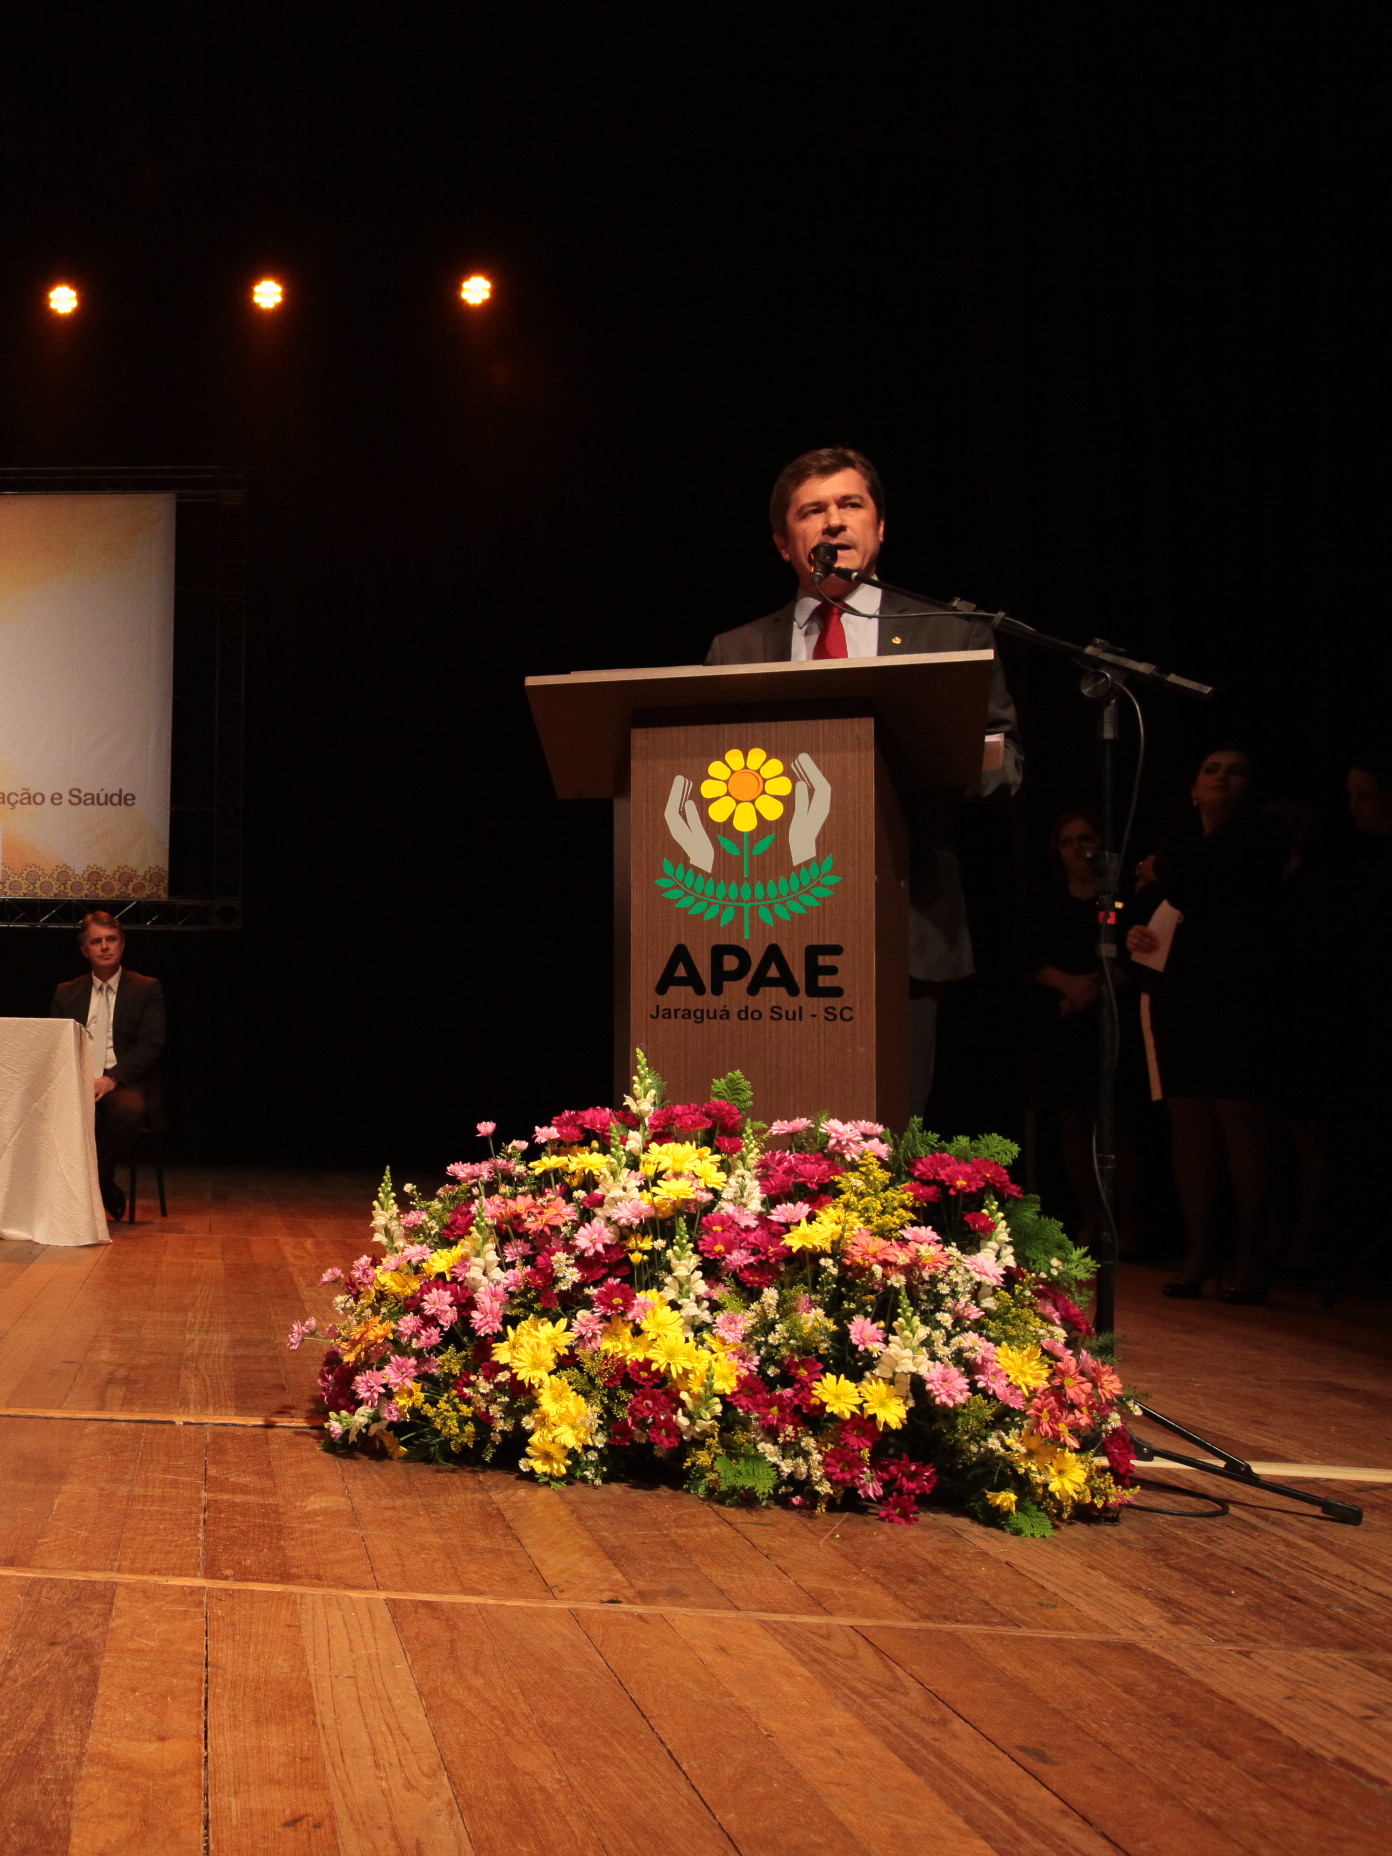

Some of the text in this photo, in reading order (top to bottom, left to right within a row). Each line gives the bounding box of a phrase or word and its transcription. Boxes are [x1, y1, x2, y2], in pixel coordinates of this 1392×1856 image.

[50, 792, 63, 806] e
[68, 787, 136, 807] Saúde
[655, 943, 844, 998] APAE
[650, 1005, 729, 1023] Jaraguá
[737, 1006, 762, 1021] do
[770, 1006, 803, 1021] Sul
[824, 1007, 854, 1022] SC
